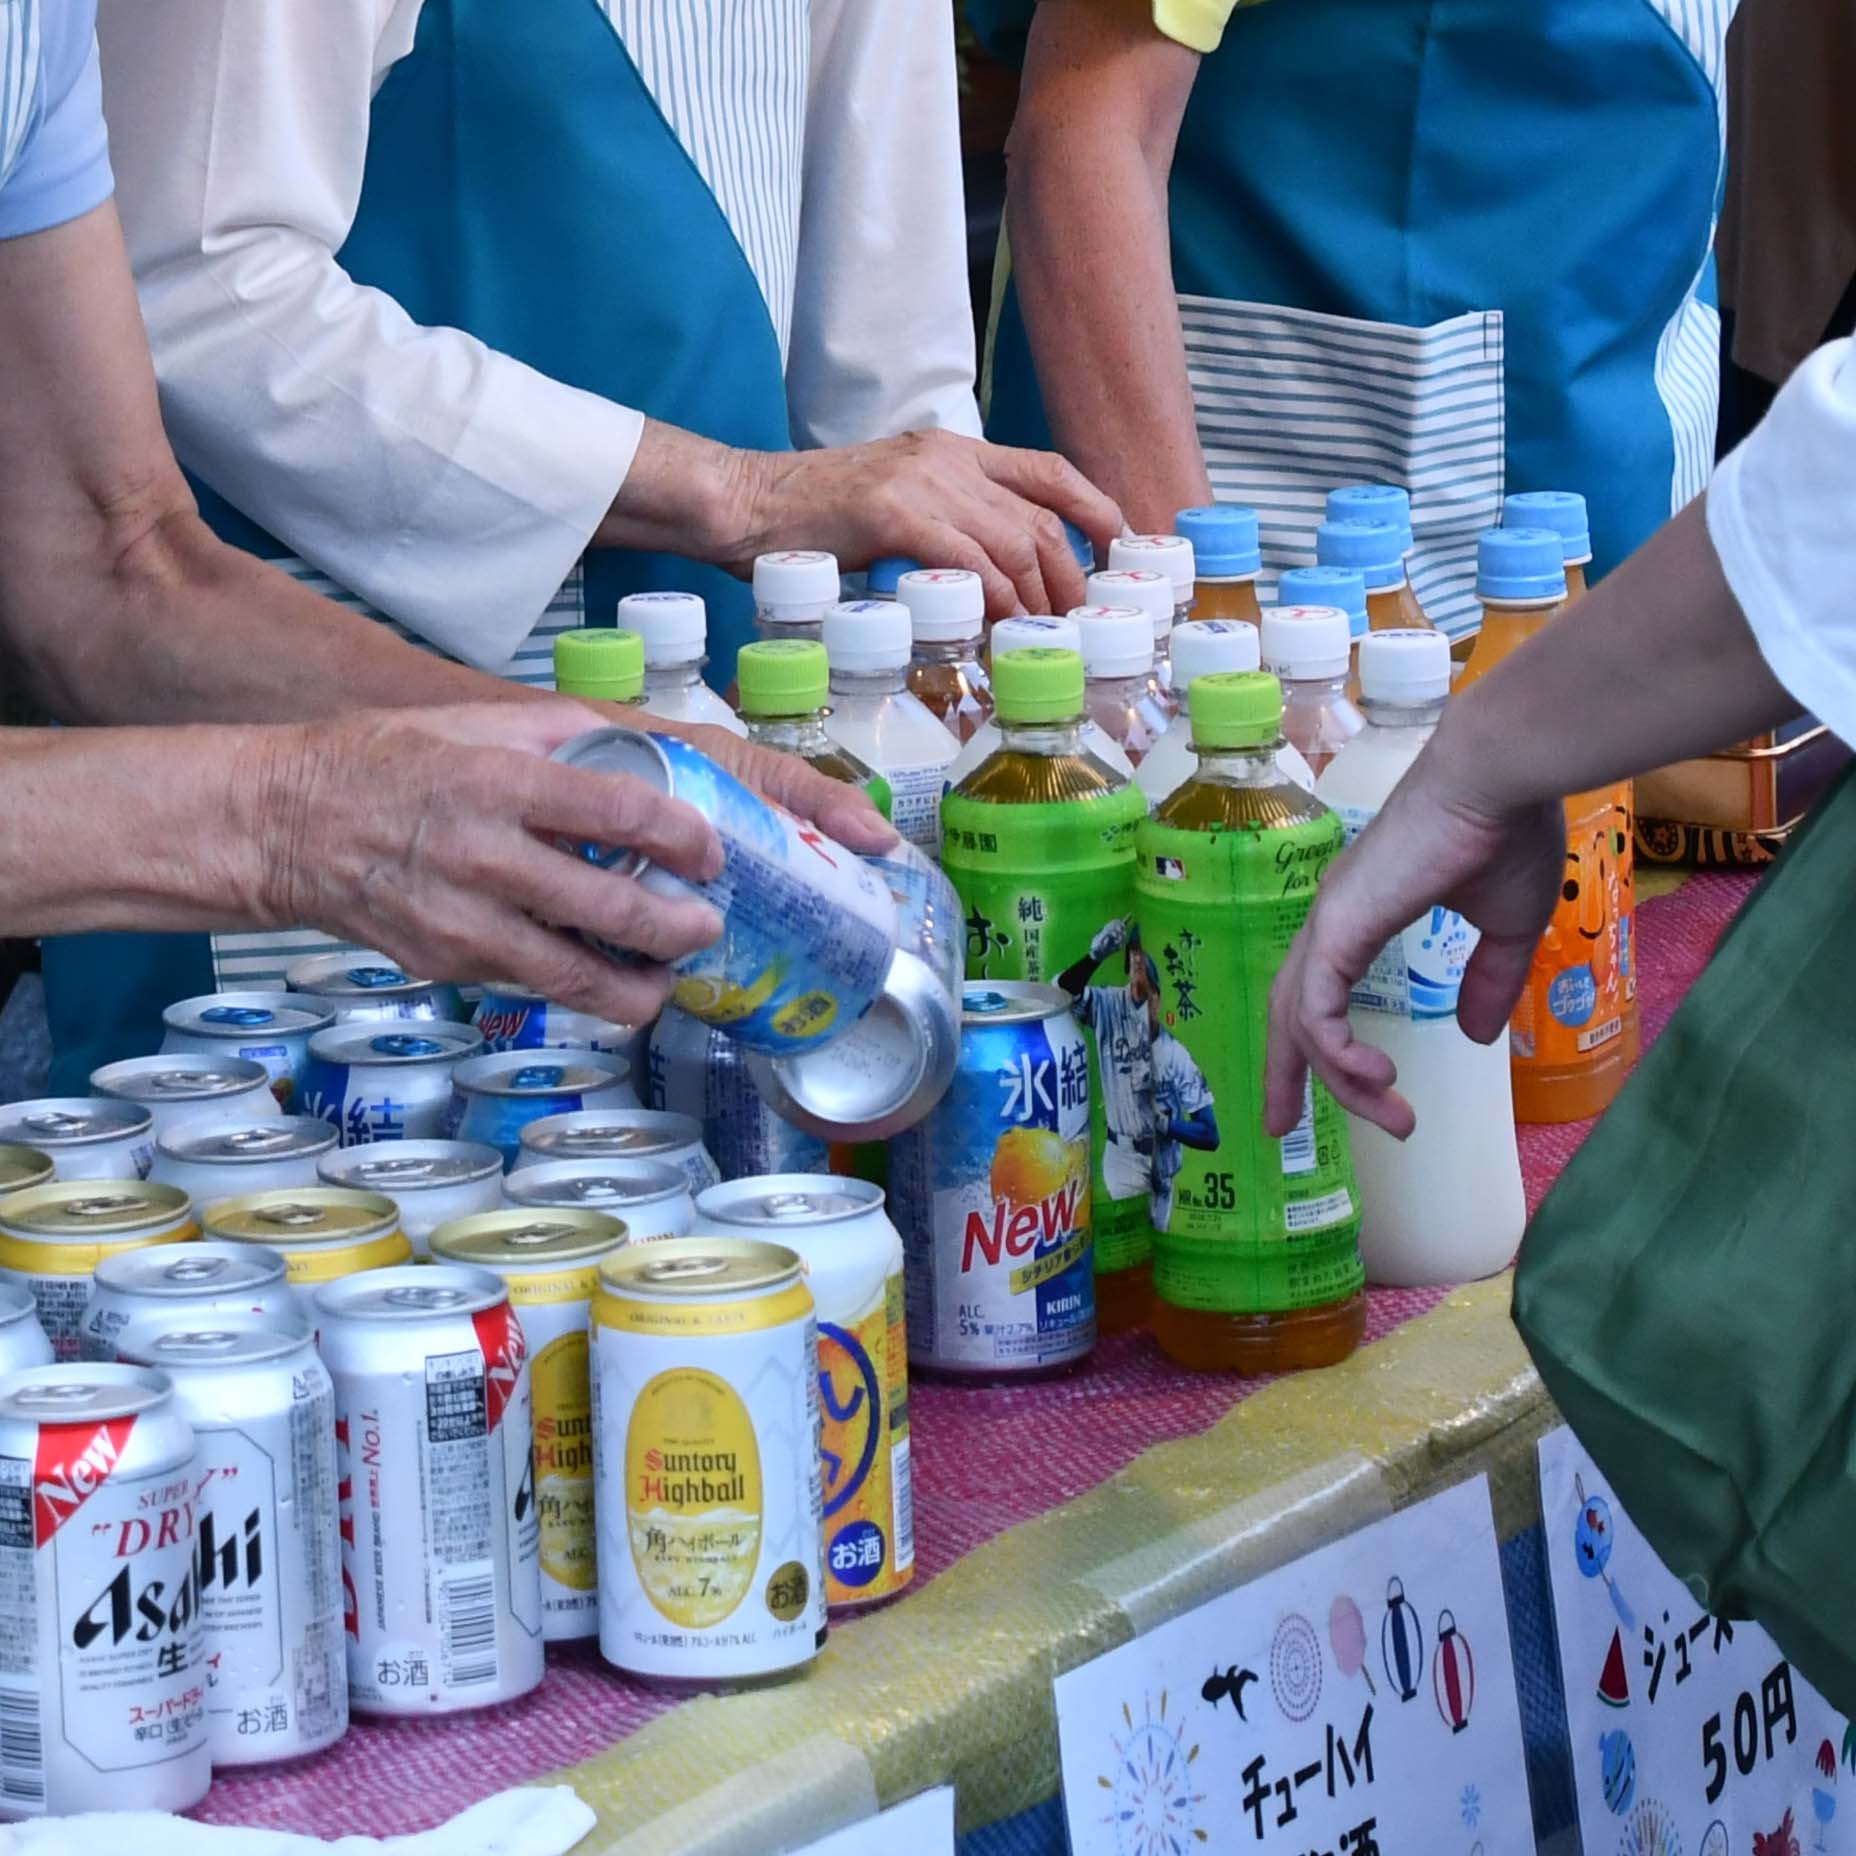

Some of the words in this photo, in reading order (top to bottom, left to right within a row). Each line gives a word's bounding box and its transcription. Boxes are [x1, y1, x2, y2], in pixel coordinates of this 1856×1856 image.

[999, 1040, 1089, 1122] 氷結
[1204, 1172, 1236, 1210] 35
[960, 1177, 1079, 1274] New
[1046, 1293, 1081, 1315] KIRIN
[36, 1424, 119, 1525] New
[644, 1448, 737, 1474] Suntory
[639, 1474, 745, 1508] Highball
[646, 1526, 745, 1553] 角ハイボール
[832, 1535, 882, 1570] お酒
[158, 1641, 189, 1679] 生
[377, 1659, 429, 1686] お酒
[236, 1703, 289, 1734] お酒
[1701, 1660, 1797, 1805] 50円
[1241, 1701, 1375, 1840] チューハイ
